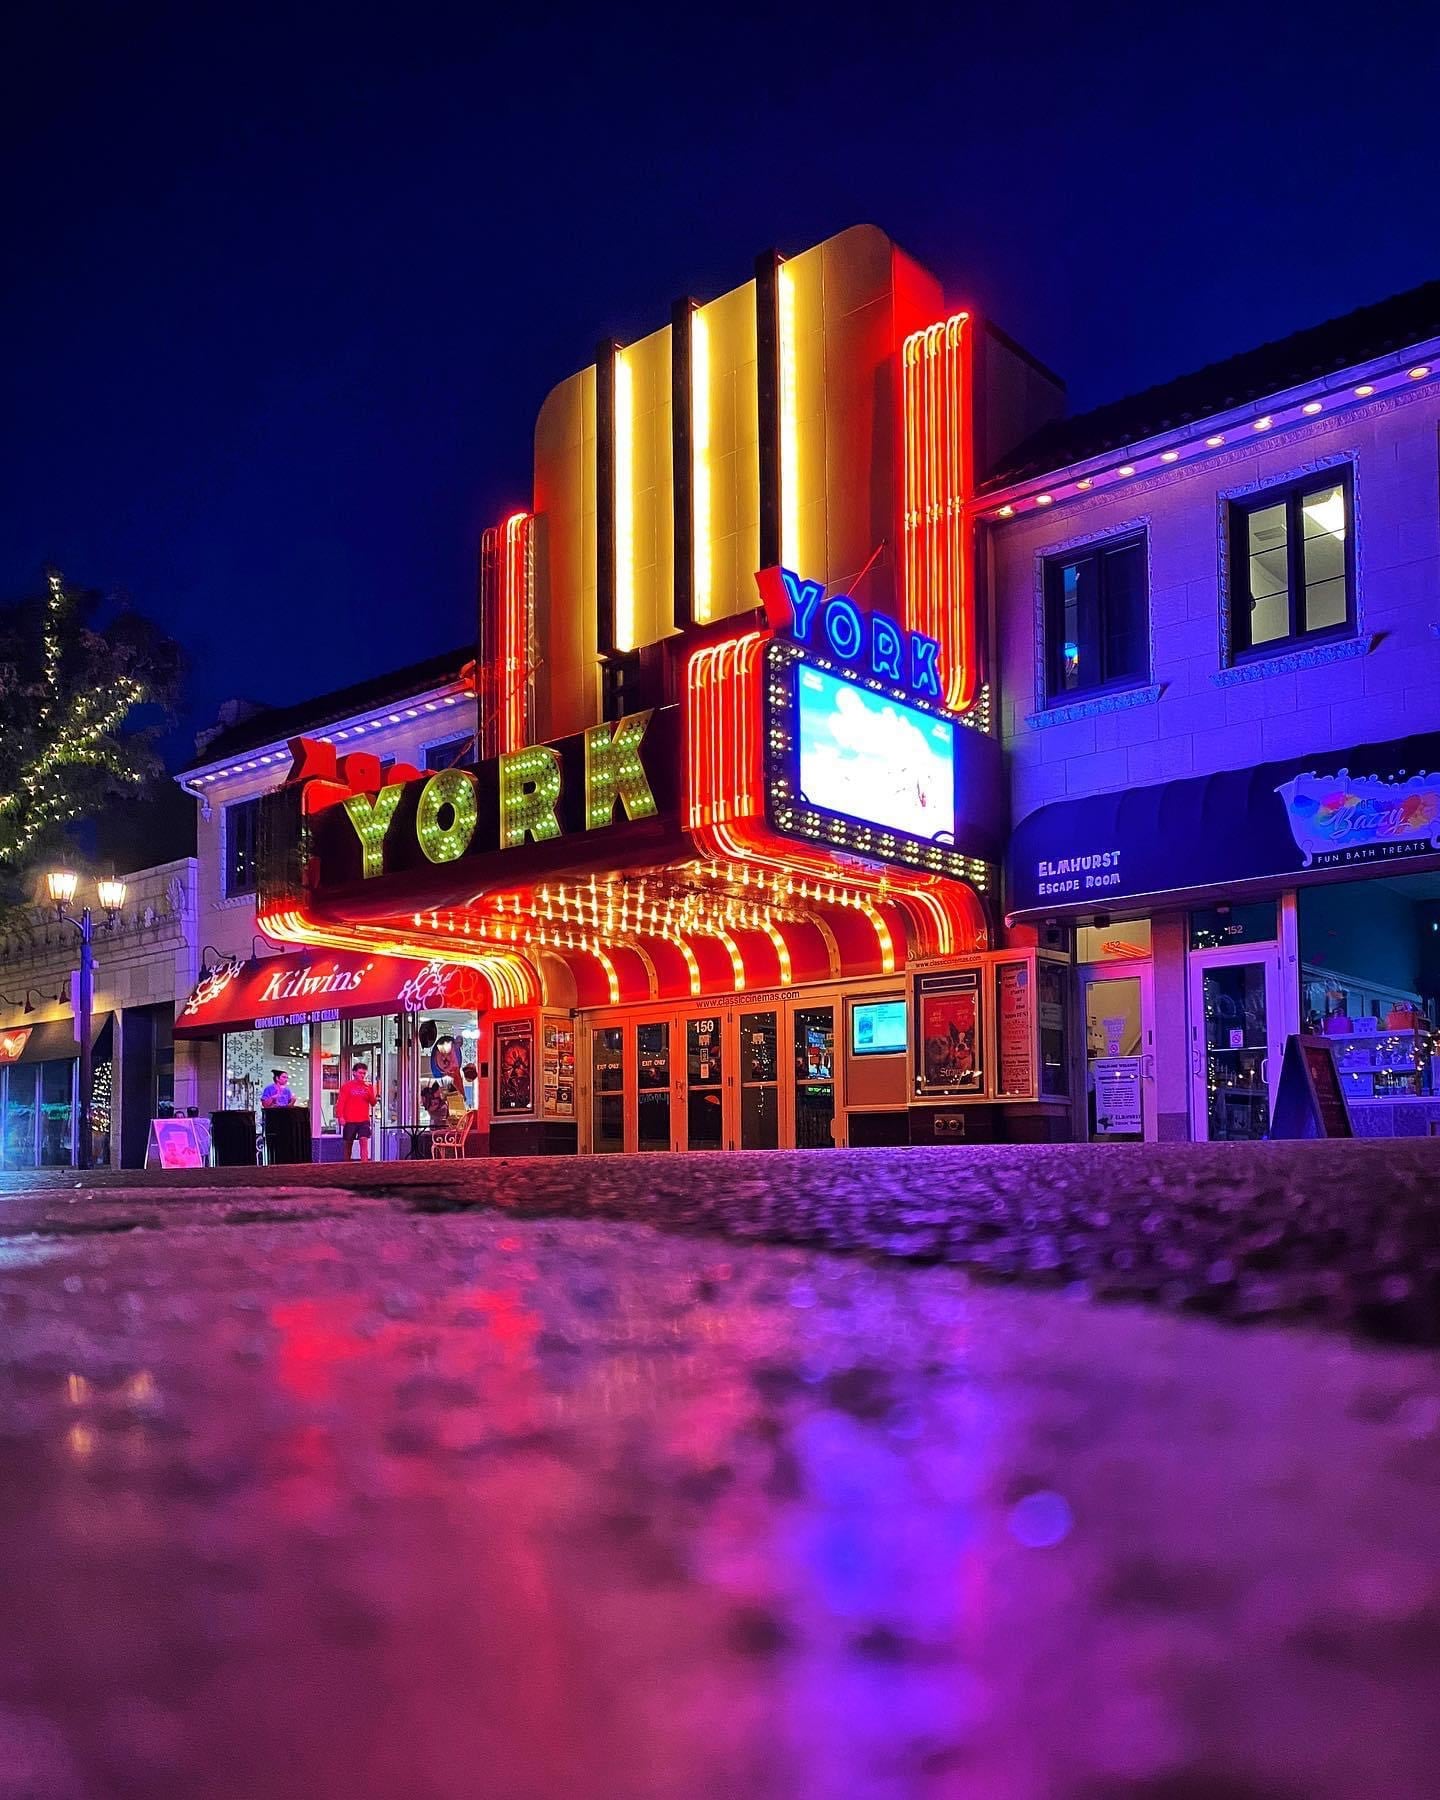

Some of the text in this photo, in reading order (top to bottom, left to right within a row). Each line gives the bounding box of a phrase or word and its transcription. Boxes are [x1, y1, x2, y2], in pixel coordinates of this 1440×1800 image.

[779, 566, 945, 702] YORK
[342, 707, 659, 880] YORK
[1320, 807, 1412, 840] Bazzy
[1038, 850, 1121, 877] ELMHURST
[1318, 842, 1425, 864] FUN BATH TREATS
[1038, 873, 1121, 896] ESCAPE ROOM
[1226, 925, 1243, 935] 152
[1107, 940, 1121, 949] 152
[258, 963, 366, 1002] Kilwins
[696, 990, 800, 1009] www.classiccinemas.com
[255, 1008, 339, 1029] CHOCOLATES FUDGE ICE CREAM
[694, 1019, 714, 1034] 150
